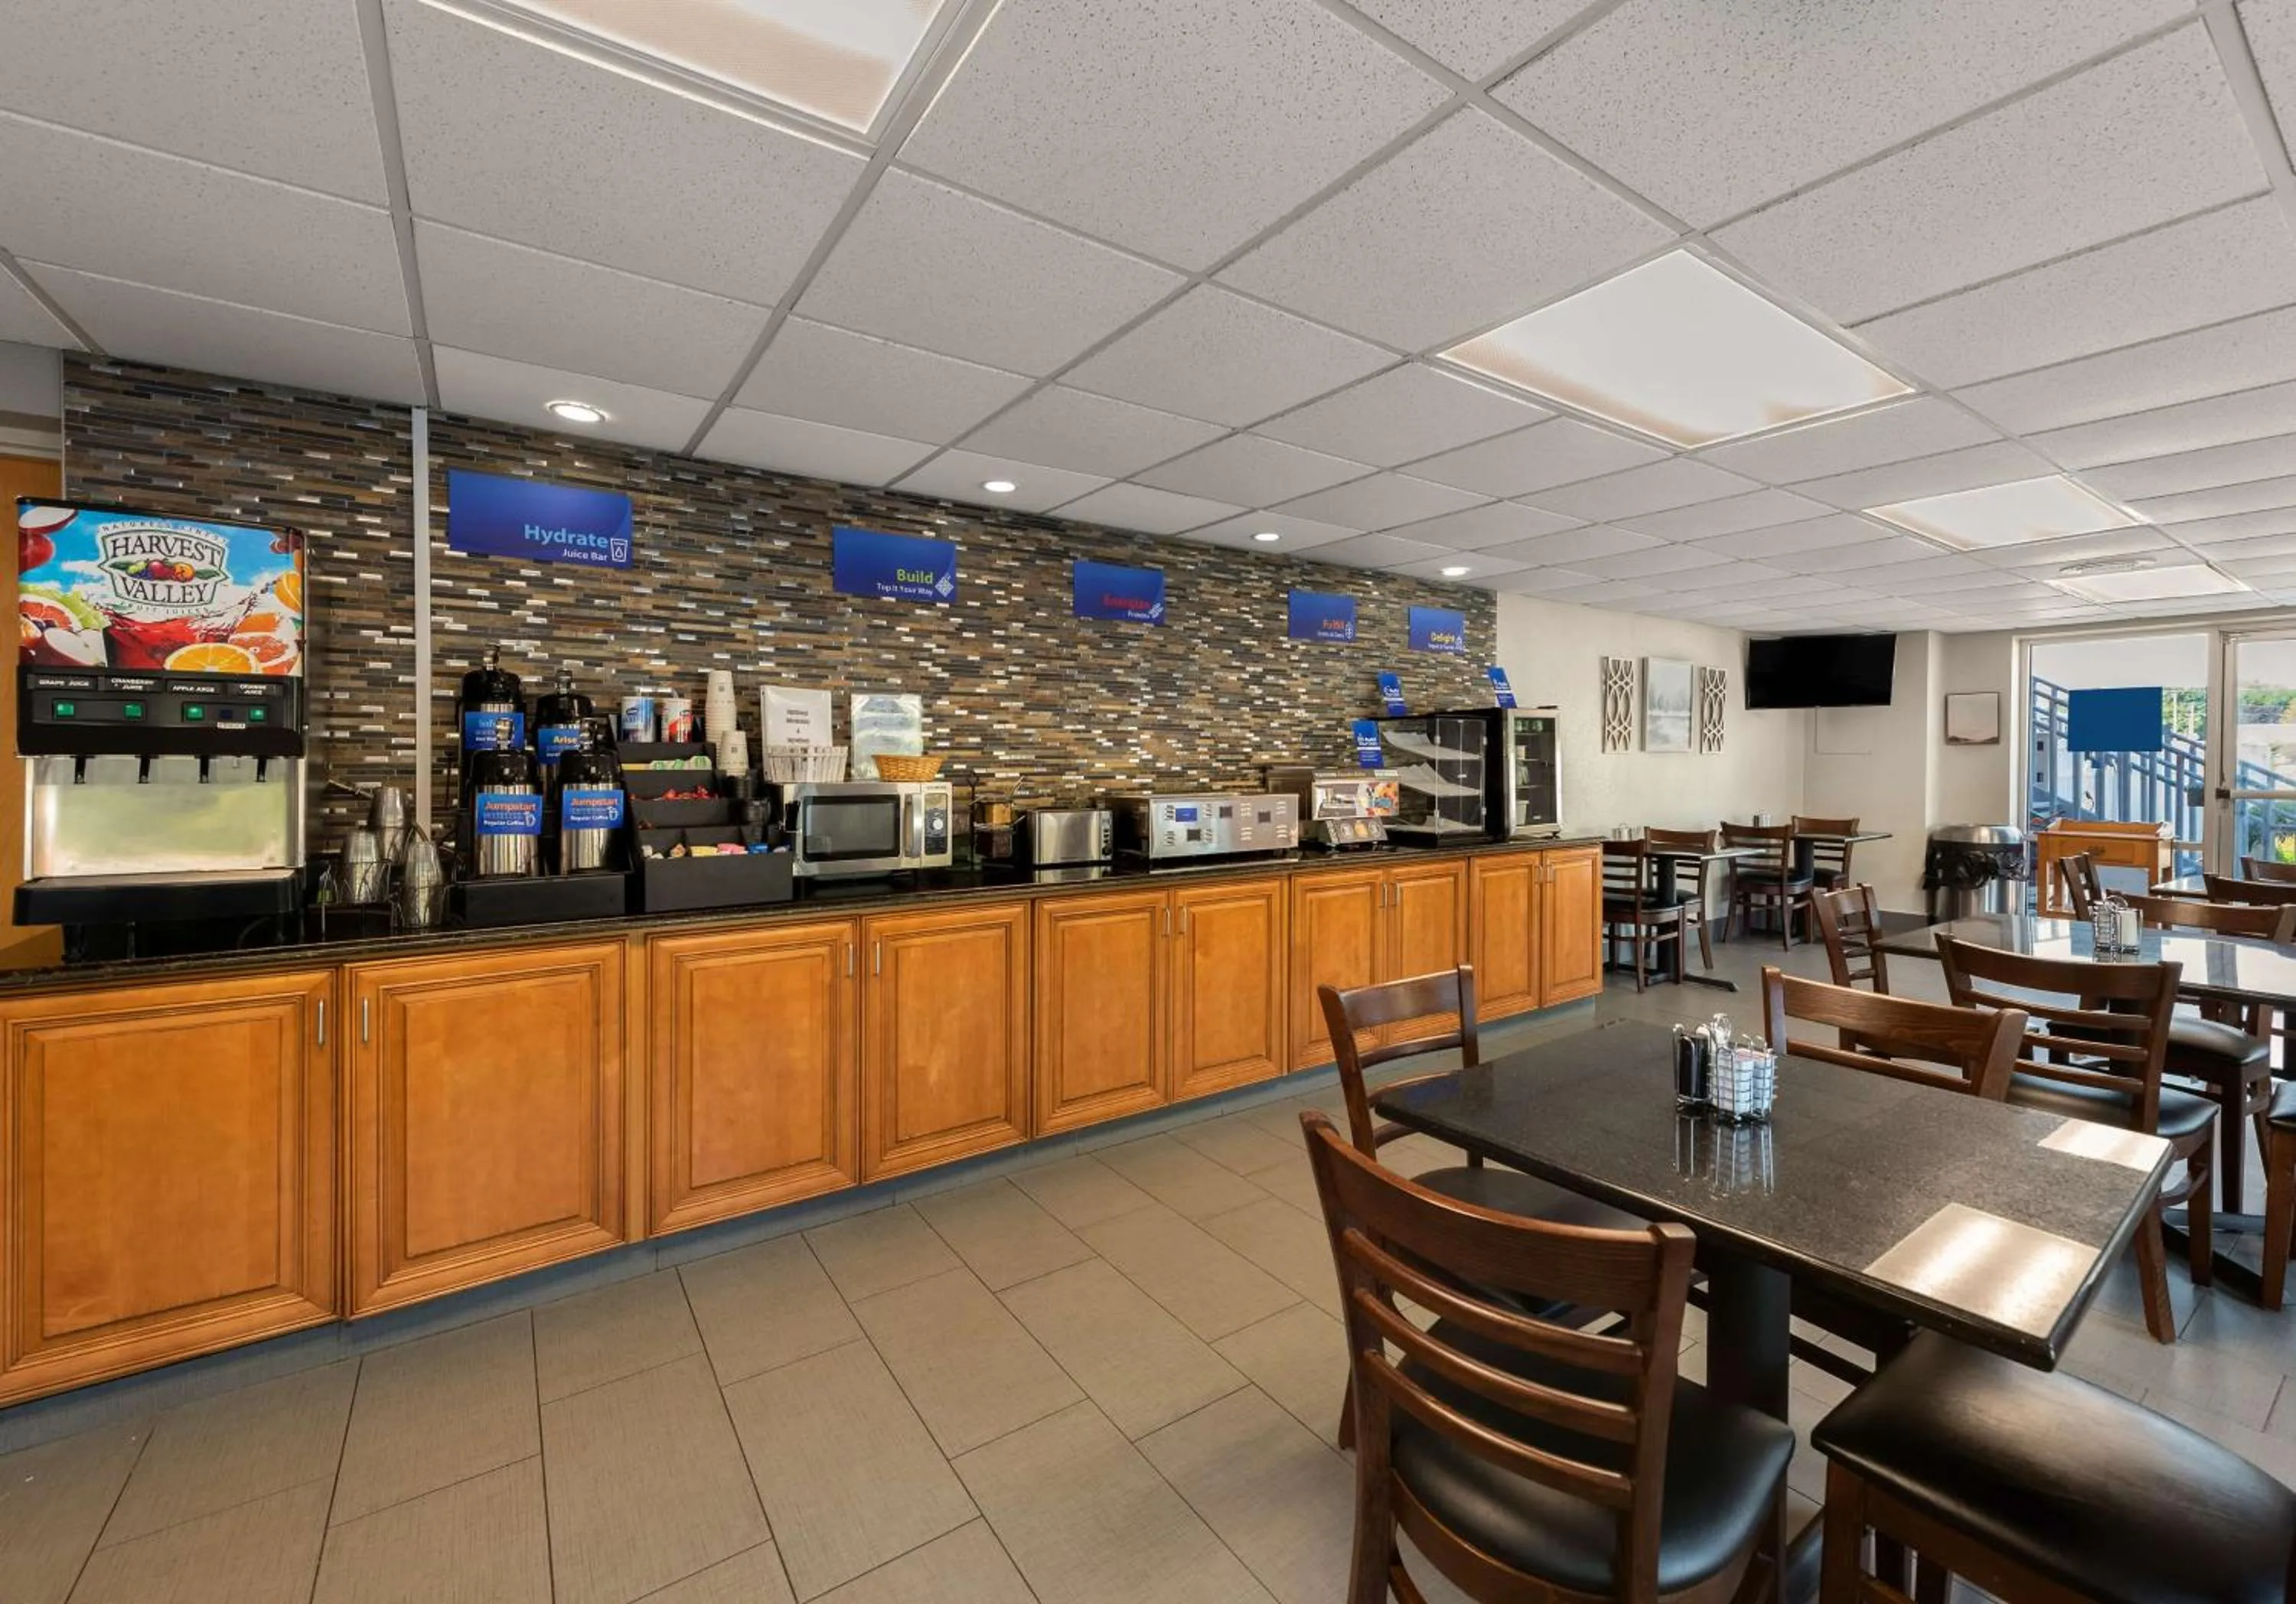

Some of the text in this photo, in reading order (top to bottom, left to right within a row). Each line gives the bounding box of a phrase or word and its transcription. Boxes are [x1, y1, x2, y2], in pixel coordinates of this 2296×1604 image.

[523, 523, 608, 549] Hydrate
[110, 534, 221, 567] HARVEST
[563, 547, 608, 561] Juice Bar
[896, 569, 933, 584] Build
[119, 575, 209, 604] VALLEY
[39, 678, 66, 686] GRAPE
[553, 735, 578, 745] Arise
[484, 801, 536, 812] Jumpstart
[570, 797, 618, 807] Jumpstart
